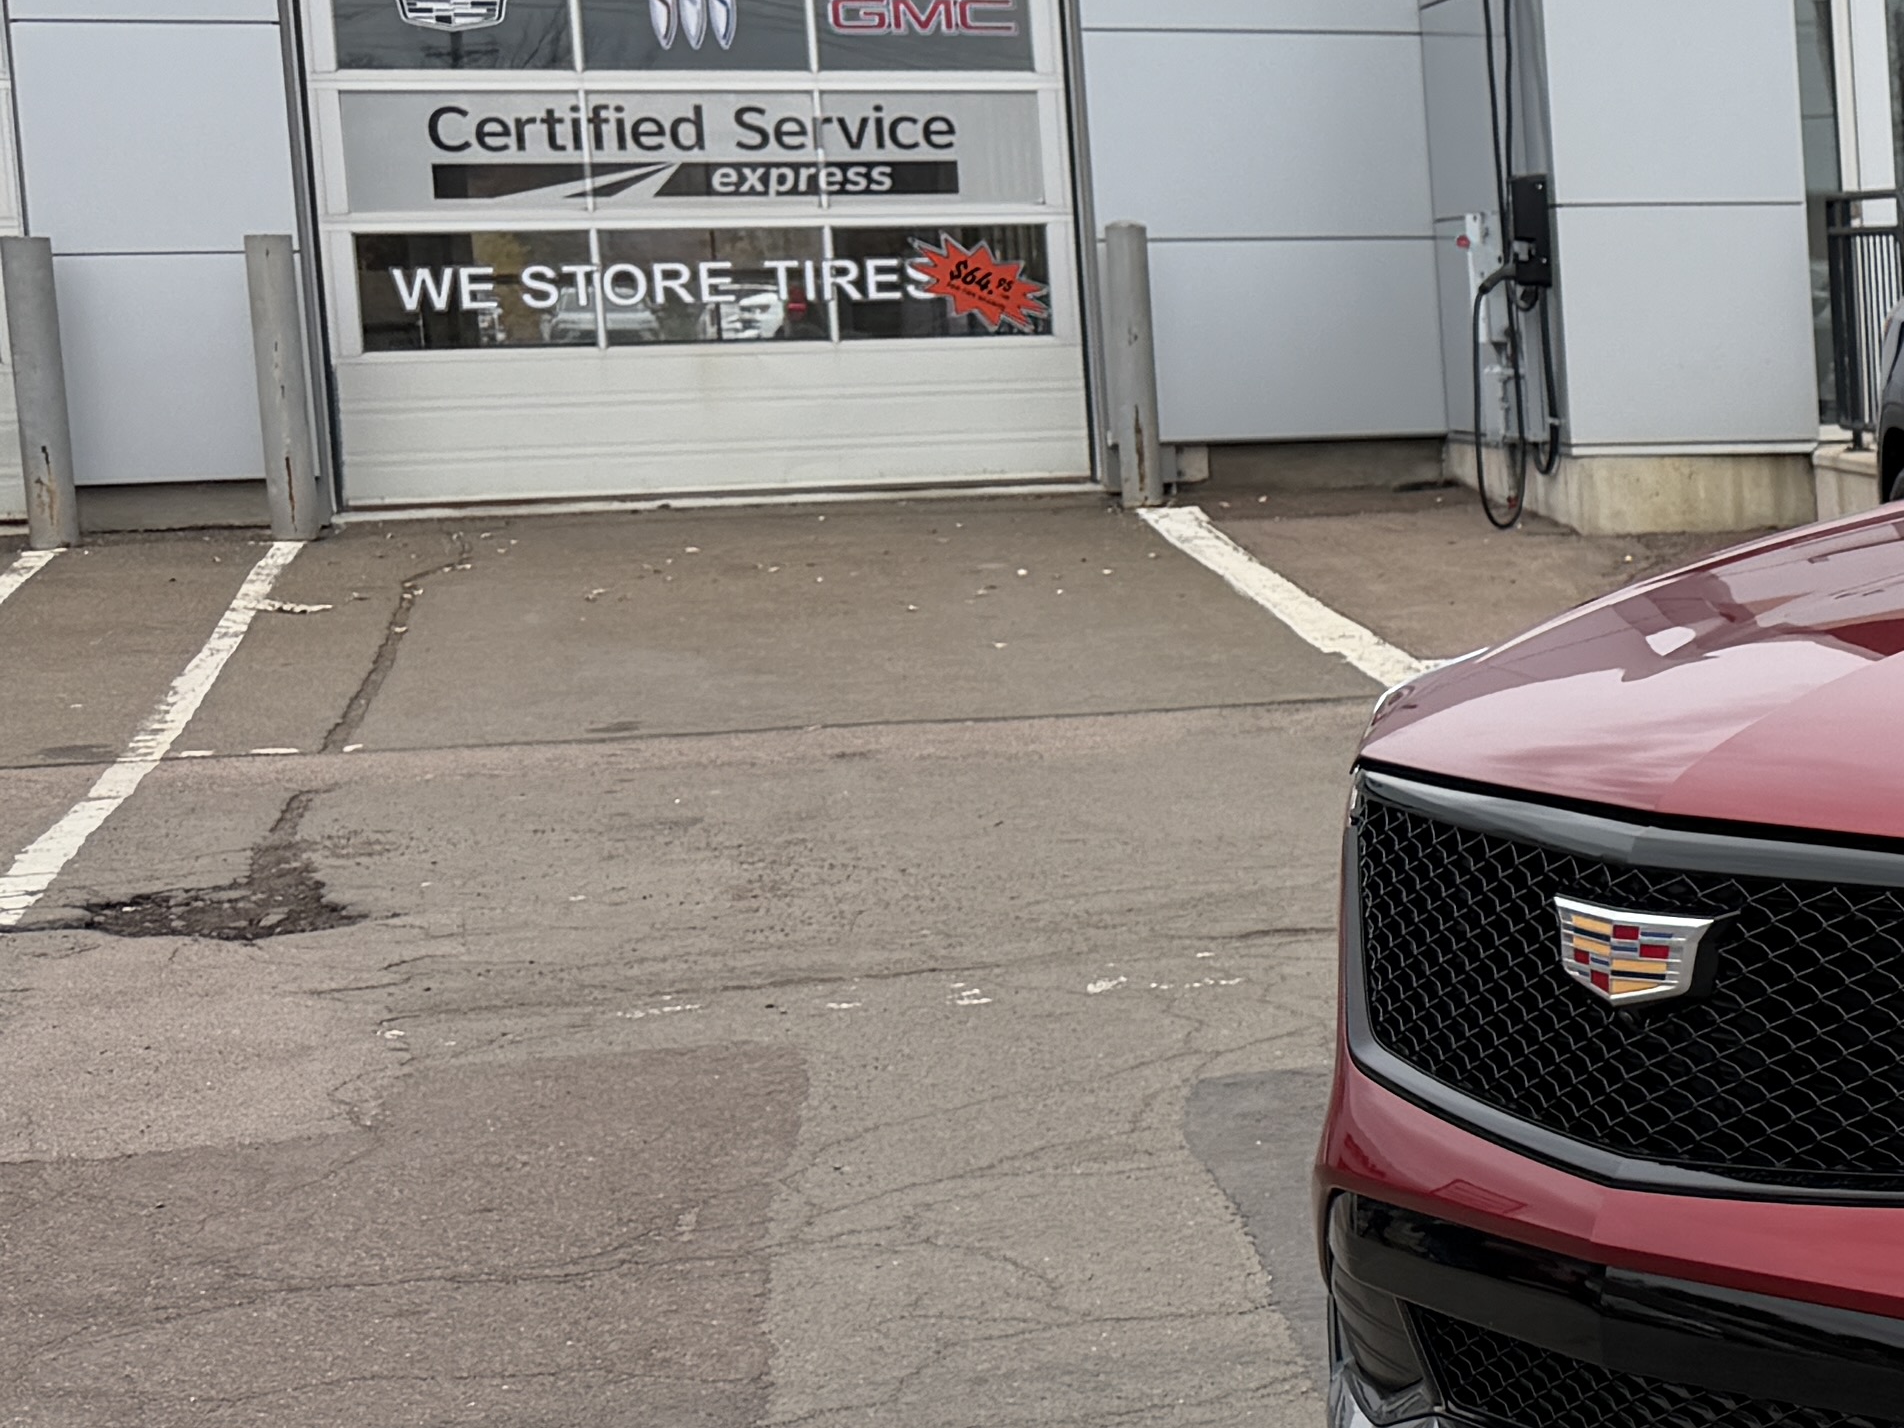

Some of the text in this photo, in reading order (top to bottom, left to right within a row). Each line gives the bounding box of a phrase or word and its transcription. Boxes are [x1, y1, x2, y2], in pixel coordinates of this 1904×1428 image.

[428, 103, 957, 153] Certified Service
[711, 160, 893, 198] express
[391, 267, 498, 312] WE
[521, 260, 733, 307] STORE
